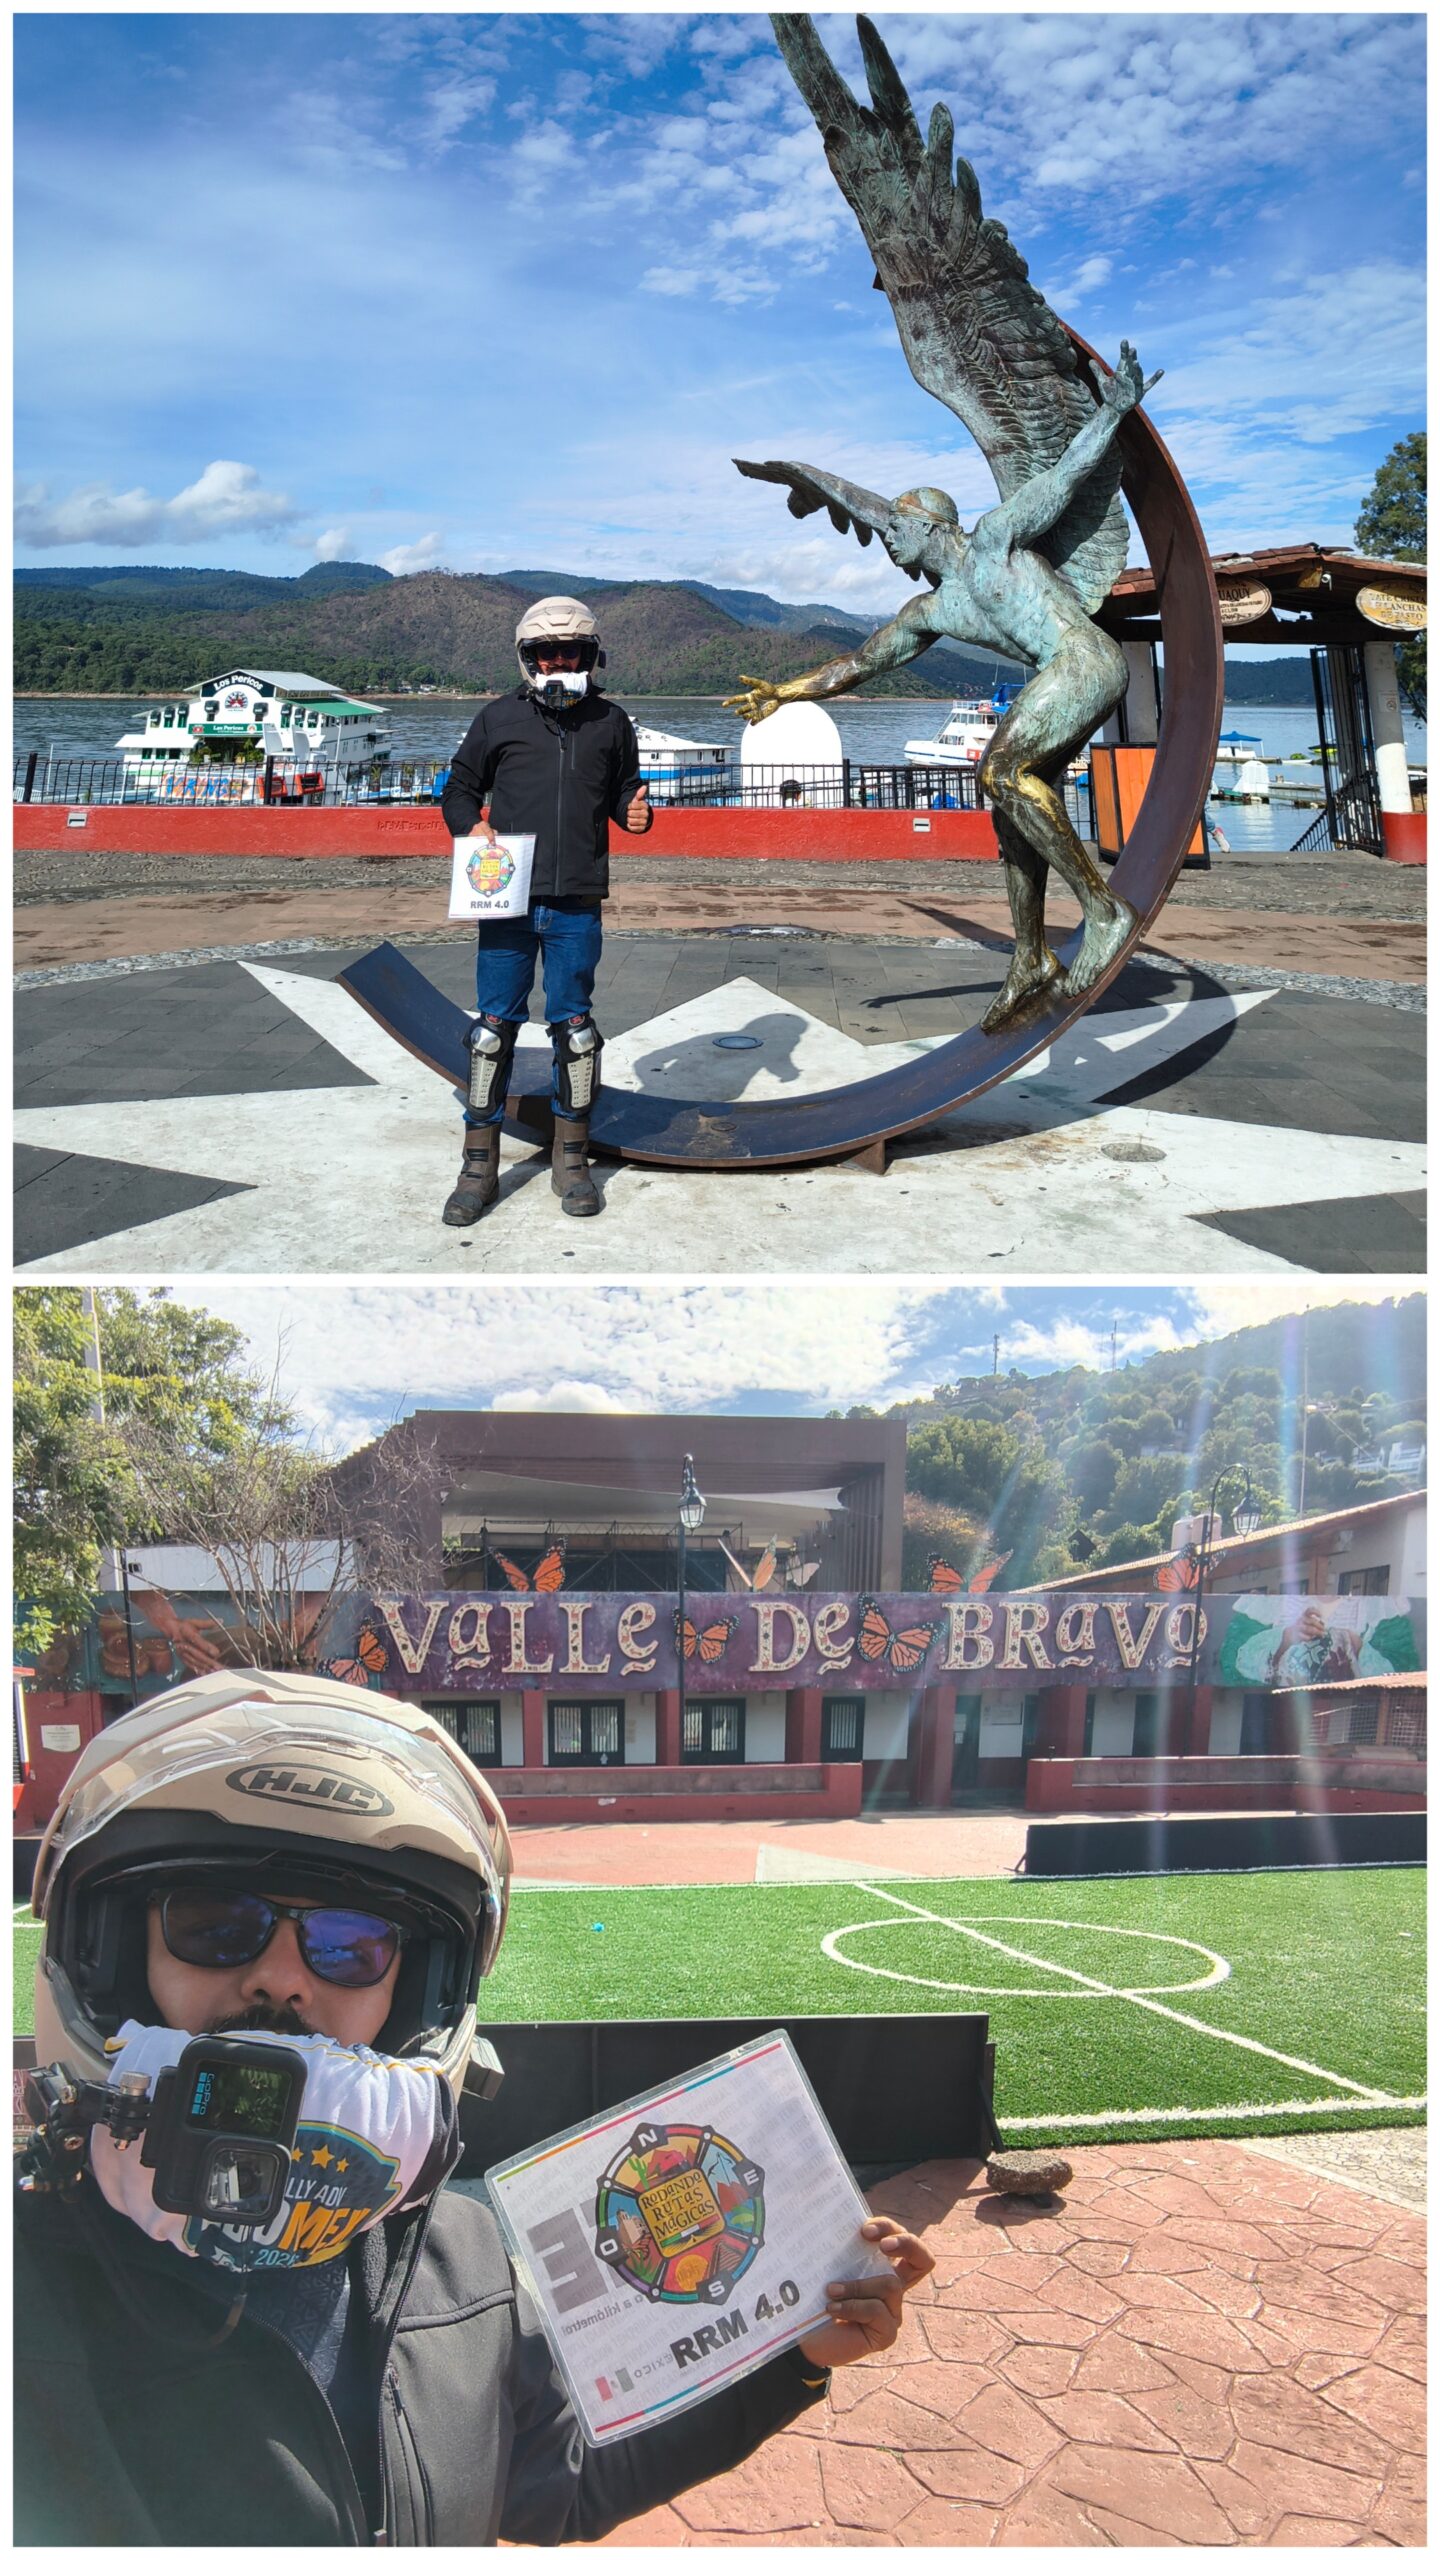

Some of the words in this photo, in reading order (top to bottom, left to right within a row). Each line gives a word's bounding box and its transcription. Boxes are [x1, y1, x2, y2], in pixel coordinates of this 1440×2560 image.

[213, 677, 230, 691] Los
[231, 675, 264, 690] Pericos
[470, 901, 492, 909] RRM
[494, 900, 510, 909] 4.0
[748, 1602, 855, 1675] De
[248, 1770, 376, 1809] HJC
[199, 2073, 215, 2115] GoPro
[638, 2129, 658, 2148] N
[743, 2169, 760, 2185] E
[284, 2177, 317, 2200] LLY
[314, 2184, 347, 2207] ADV
[600, 2238, 618, 2256] O
[708, 2280, 725, 2297] S
[669, 2308, 749, 2369] RRM
[754, 2279, 800, 2321] 4.0
